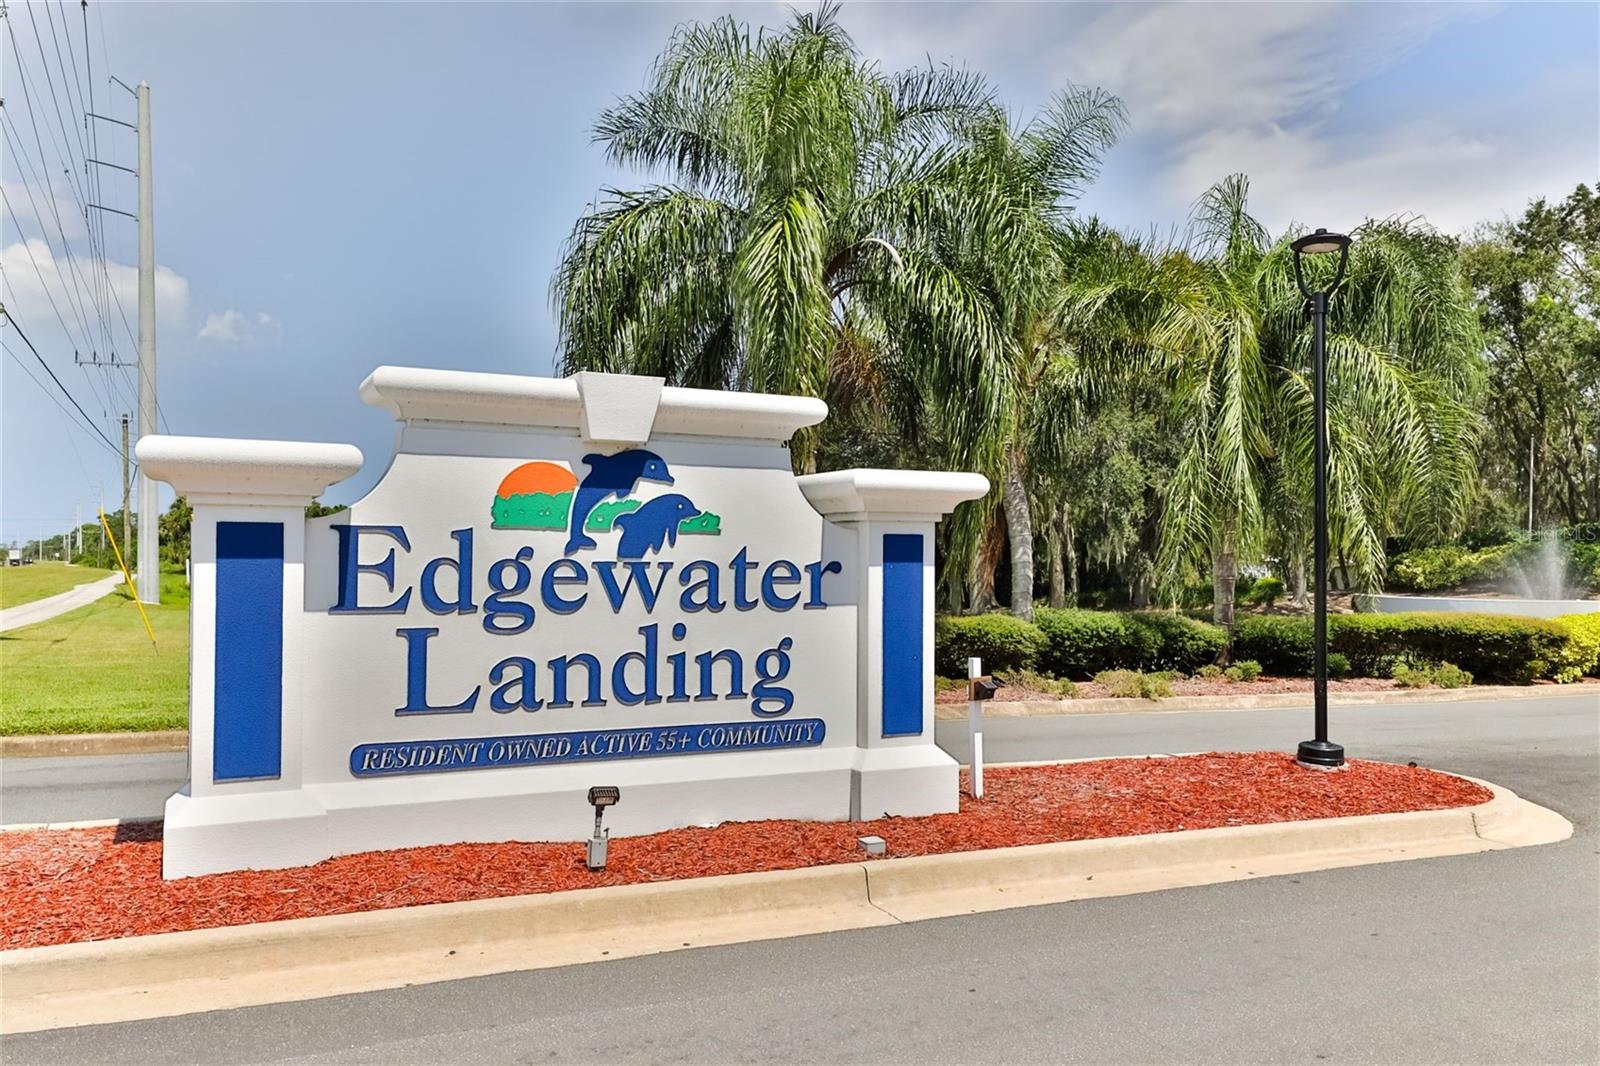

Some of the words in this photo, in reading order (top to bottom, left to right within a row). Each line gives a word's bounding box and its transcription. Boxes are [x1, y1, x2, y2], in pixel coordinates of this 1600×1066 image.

[328, 525, 842, 635] Edgewater
[395, 622, 795, 717] Landing
[361, 742, 485, 770] RESIDENT
[488, 736, 572, 762] OWNED
[576, 731, 652, 757] ACTIVE
[656, 730, 692, 751] 55+
[697, 722, 820, 749] COMMUNITY
